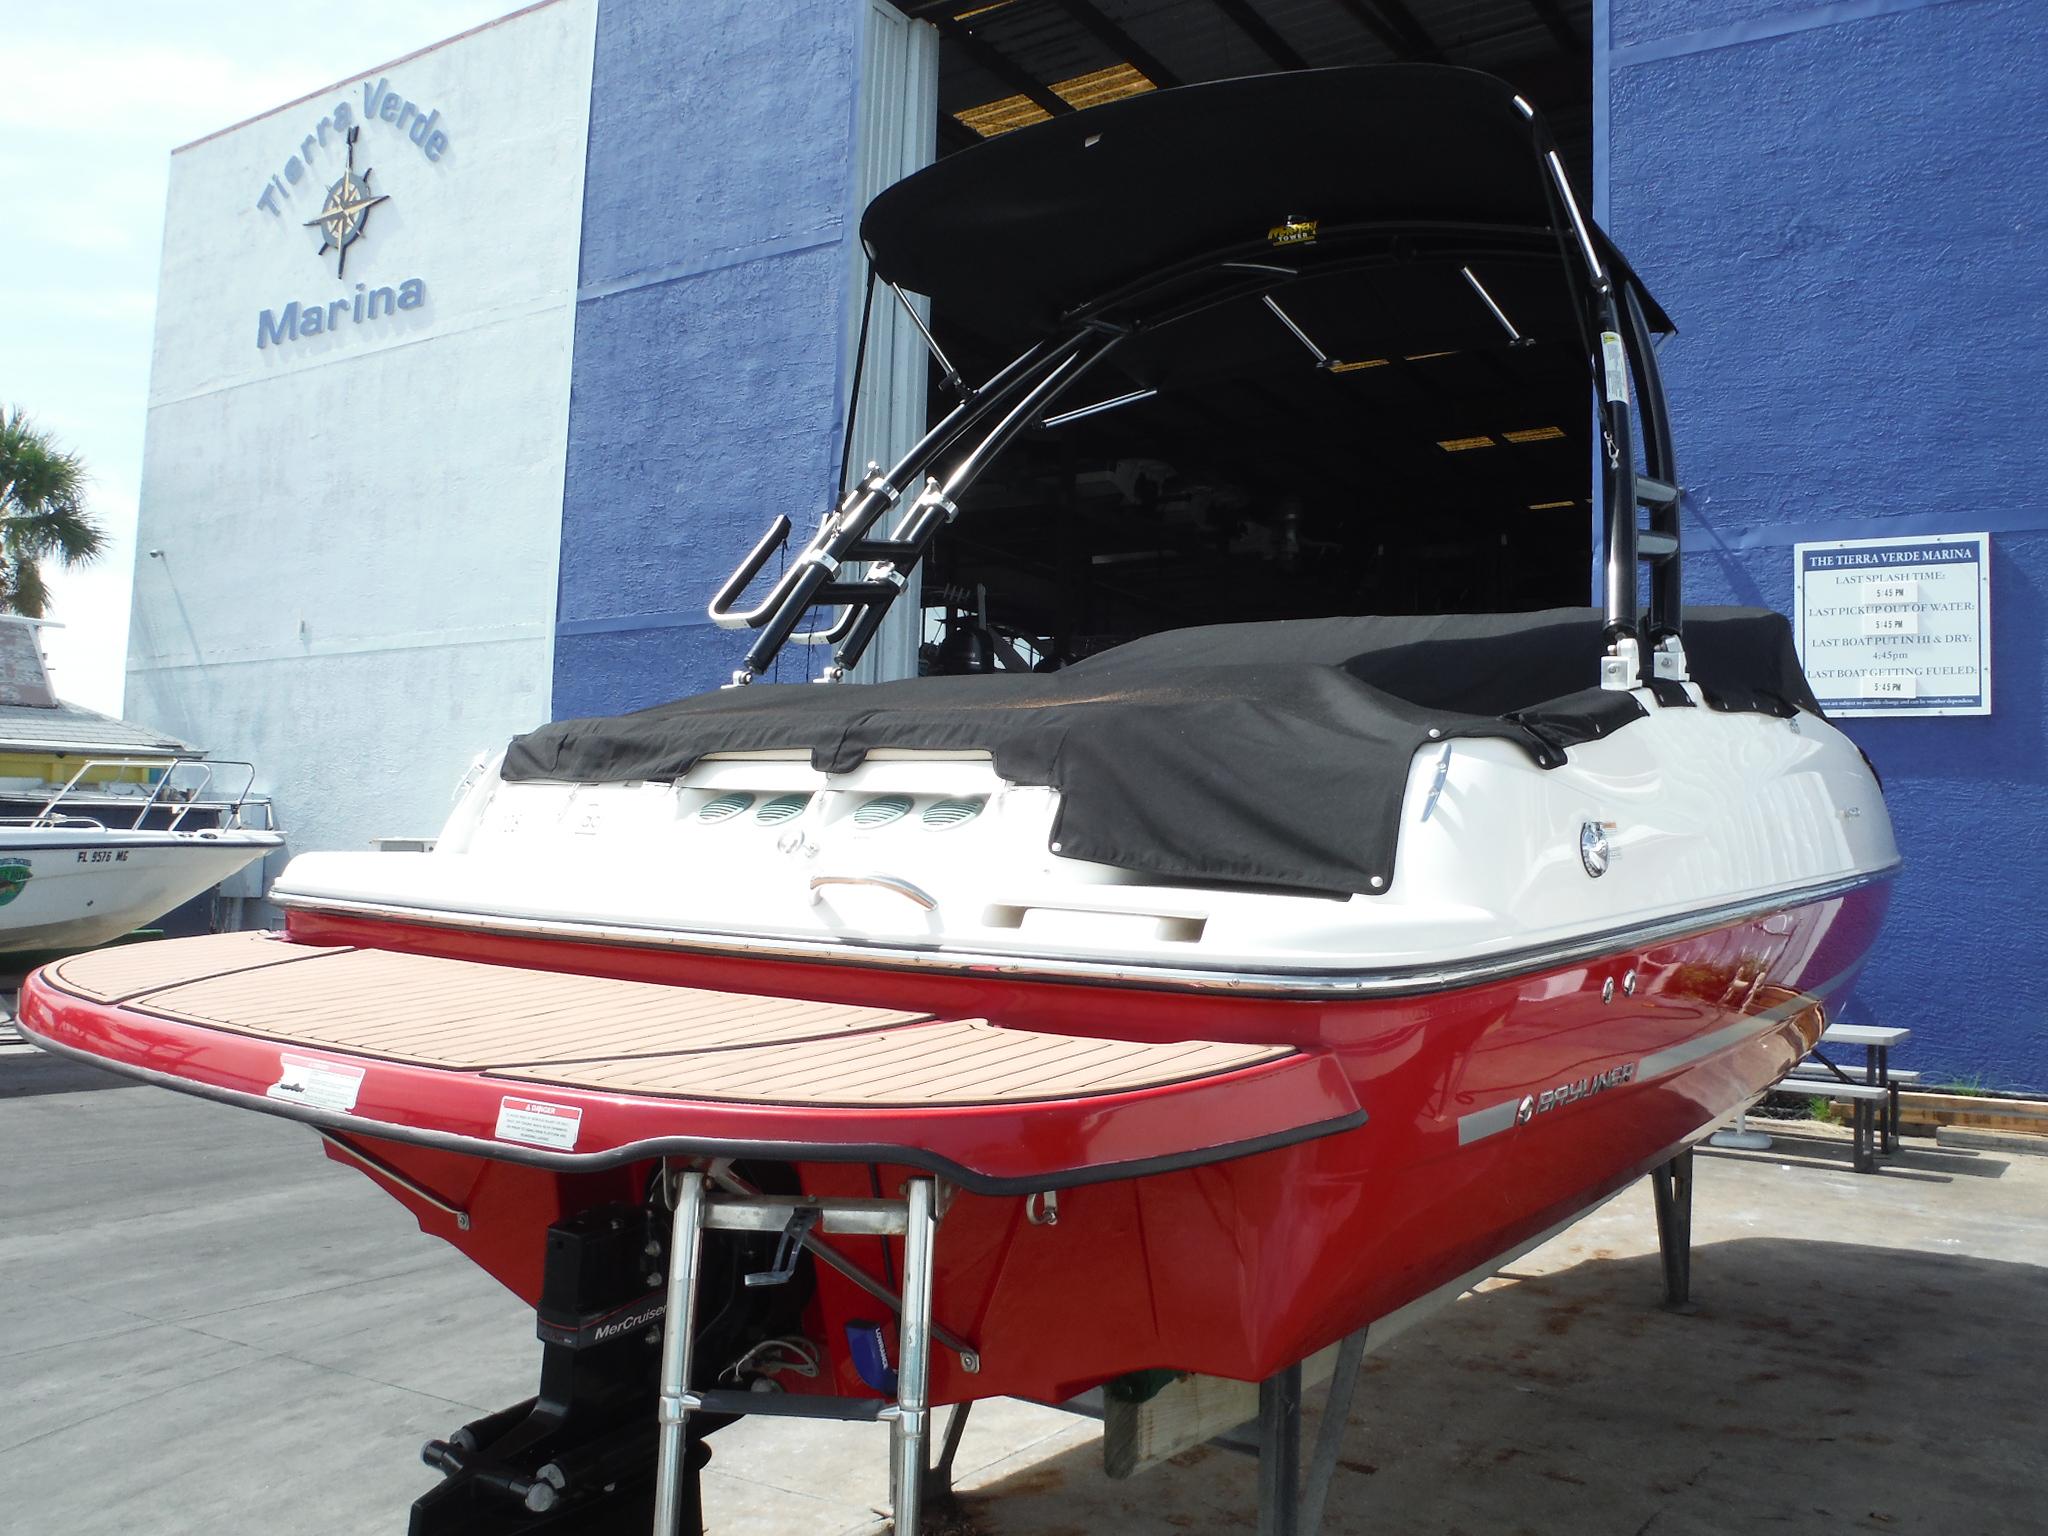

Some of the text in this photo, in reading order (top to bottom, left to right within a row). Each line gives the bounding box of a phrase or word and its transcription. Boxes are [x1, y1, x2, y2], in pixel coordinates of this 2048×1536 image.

[257, 77, 448, 217] Tierra Verde
[257, 278, 426, 349] Marina
[1810, 548, 1972, 567] THE TIERRA VERDE MARINA
[1835, 571, 1946, 585] LAST SPLASH TIME:
[1876, 588, 1904, 597] 5:45 PM
[1809, 602, 1975, 617] LAST PICKUP OUT OF WATER:
[1894, 620, 1903, 629] PM
[1812, 634, 1972, 648] LAST BOAT PUT IN HI & DRY:
[1872, 651, 1908, 662] 4:45pm
[1807, 666, 1977, 679] LAST BOAT GETTING FUELED:
[1892, 683, 1901, 692] PM
[77, 851, 88, 863] FL
[1536, 1063, 1635, 1113] BAYLINER
[594, 1304, 668, 1340] MerCruiser
